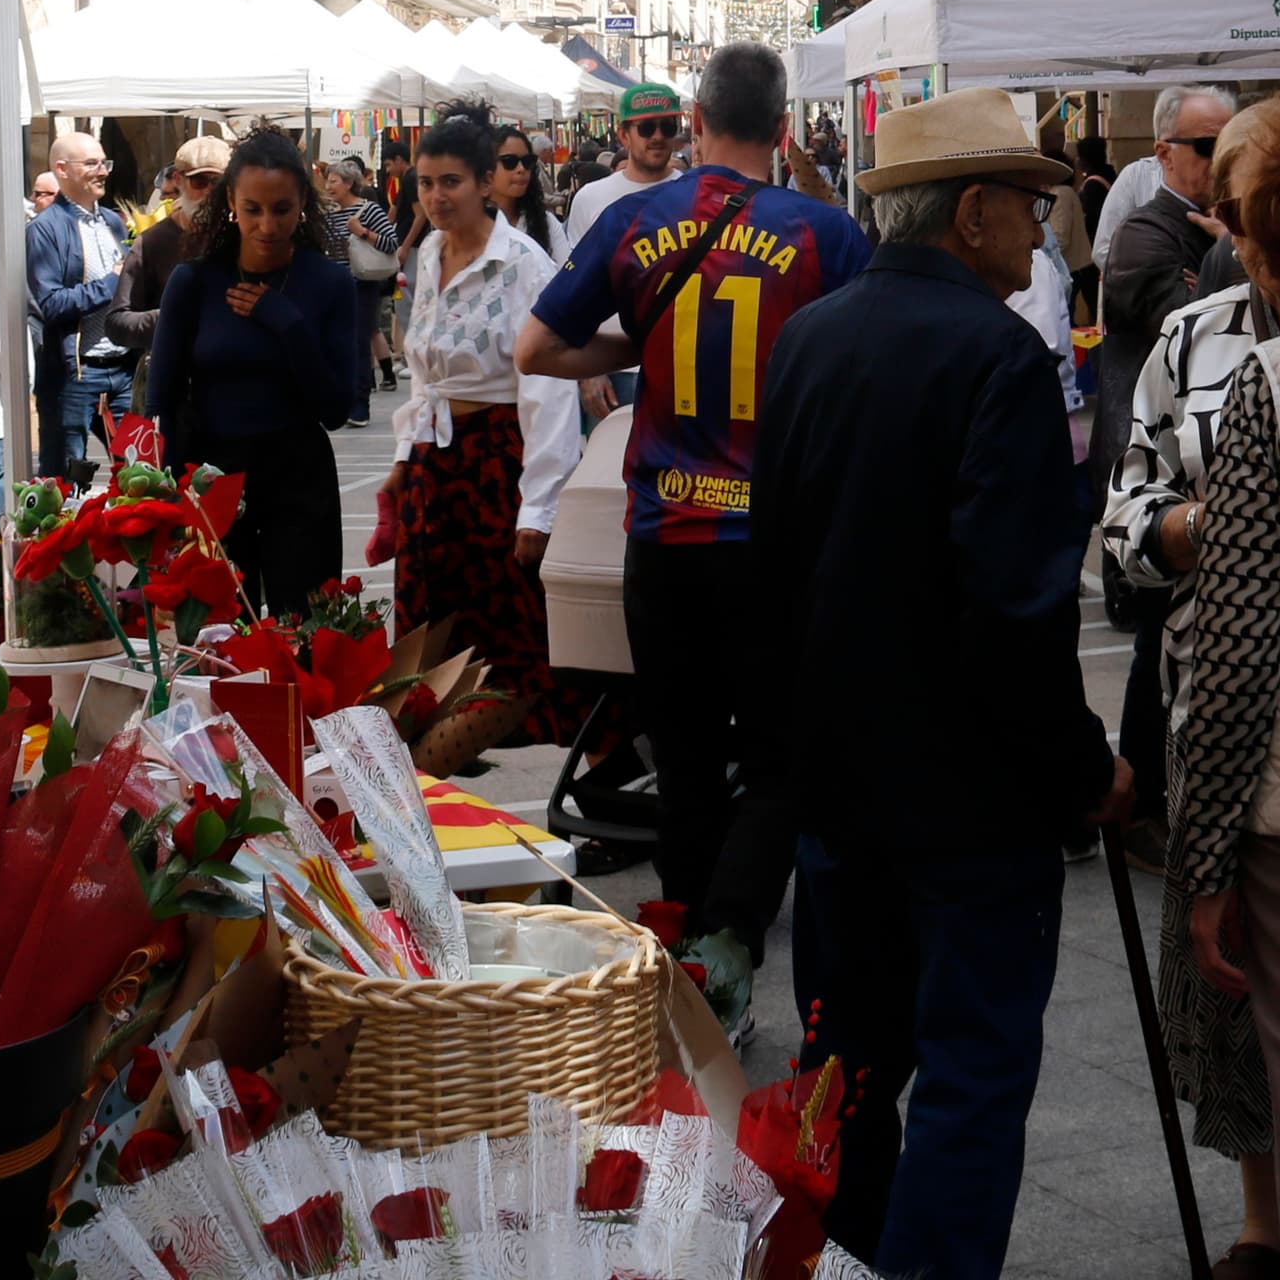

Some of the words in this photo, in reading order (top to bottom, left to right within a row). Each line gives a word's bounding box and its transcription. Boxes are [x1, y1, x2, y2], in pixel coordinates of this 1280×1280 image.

[656, 272, 762, 421] 11
[128, 424, 155, 456] 10
[693, 487, 750, 508] ACNUR
